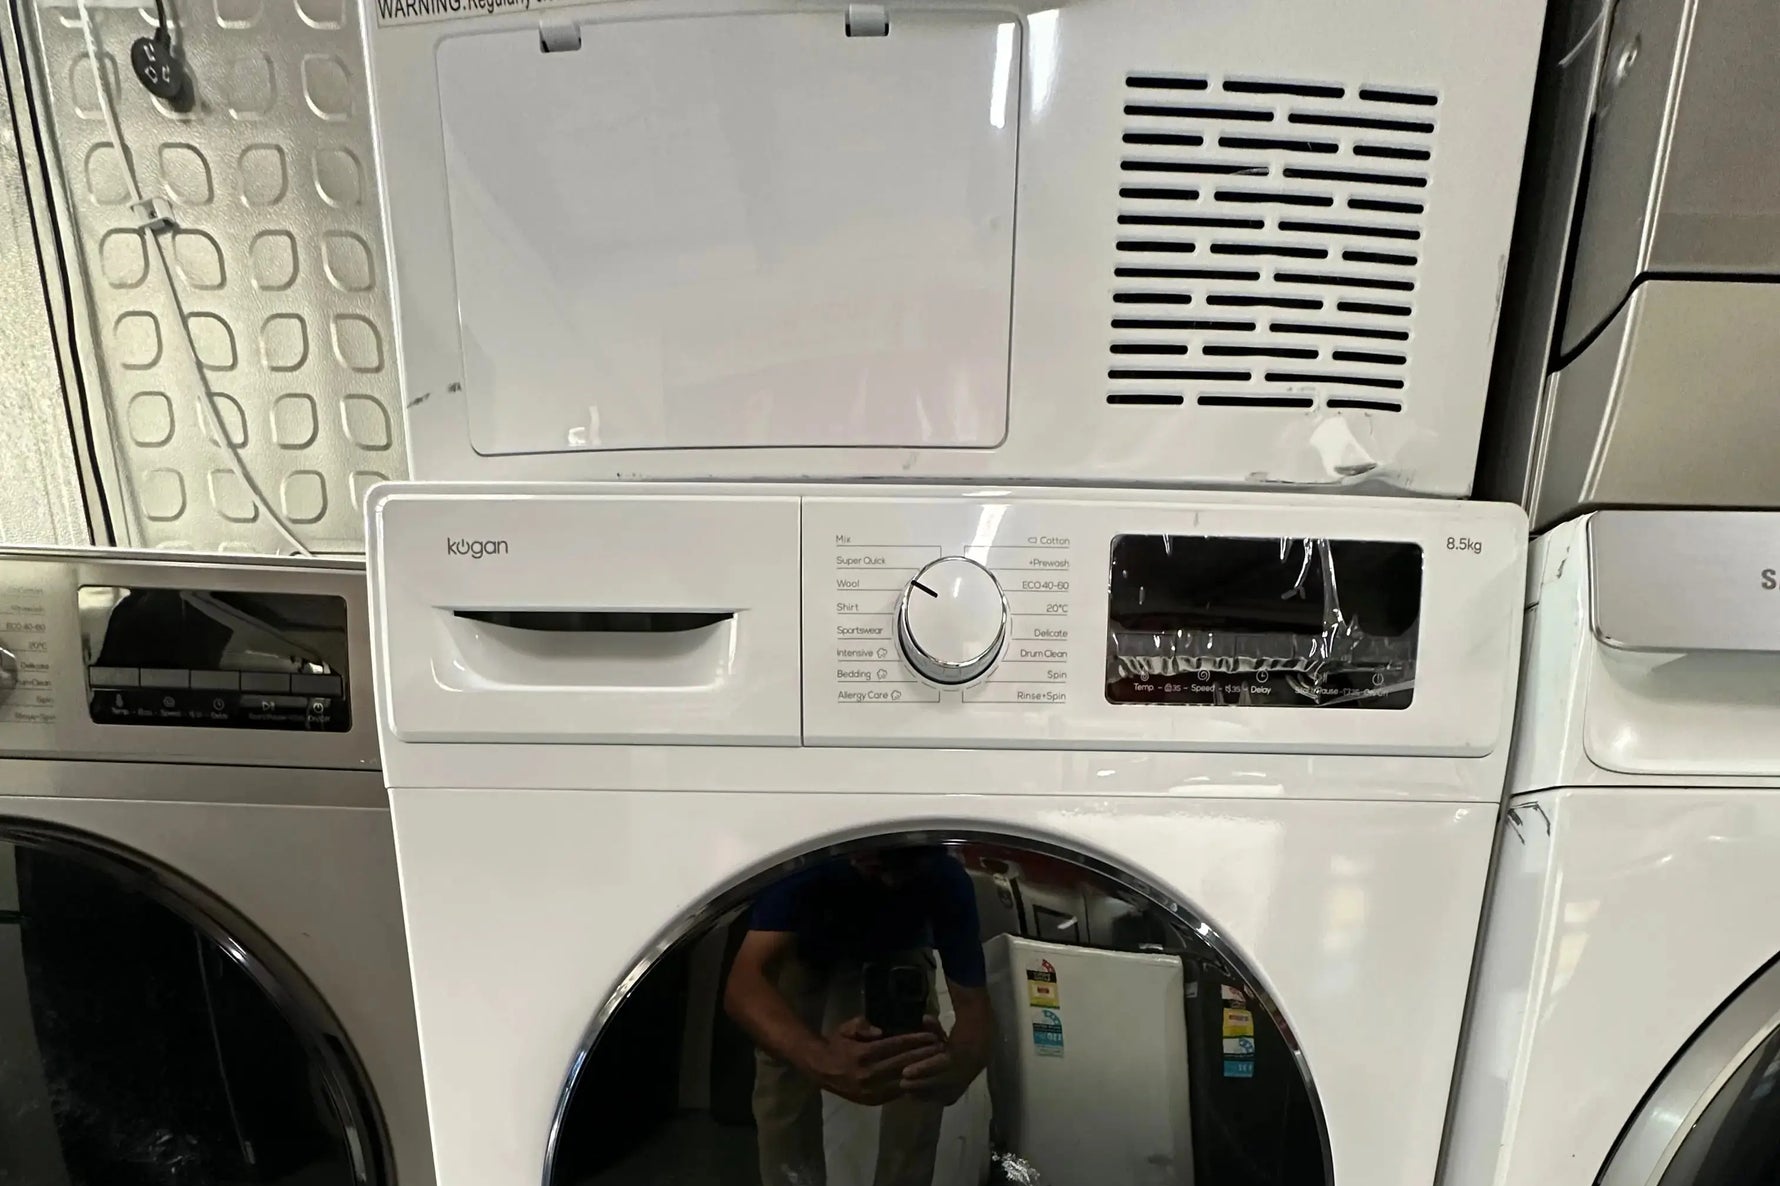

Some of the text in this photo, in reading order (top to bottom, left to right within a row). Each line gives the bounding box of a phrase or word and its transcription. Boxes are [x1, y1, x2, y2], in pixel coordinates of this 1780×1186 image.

[835, 534, 851, 543] Mix
[1039, 536, 1070, 545] Cotton
[447, 537, 508, 559] kogan
[1446, 536, 1482, 554] 8.5kg
[836, 555, 885, 566] Super Quick
[836, 579, 860, 588] Wool
[1761, 568, 1780, 590] S
[836, 602, 859, 612] Shirt
[836, 625, 883, 636] Sportswear
[1034, 628, 1068, 638] Delicate
[836, 648, 873, 657] Intensive
[837, 669, 871, 681] Bedding
[1047, 670, 1067, 680] Spin
[1133, 682, 1155, 692] Temp
[1191, 683, 1215, 693] Speed
[1250, 685, 1273, 695] Delay
[838, 690, 888, 703] Allergy Care
